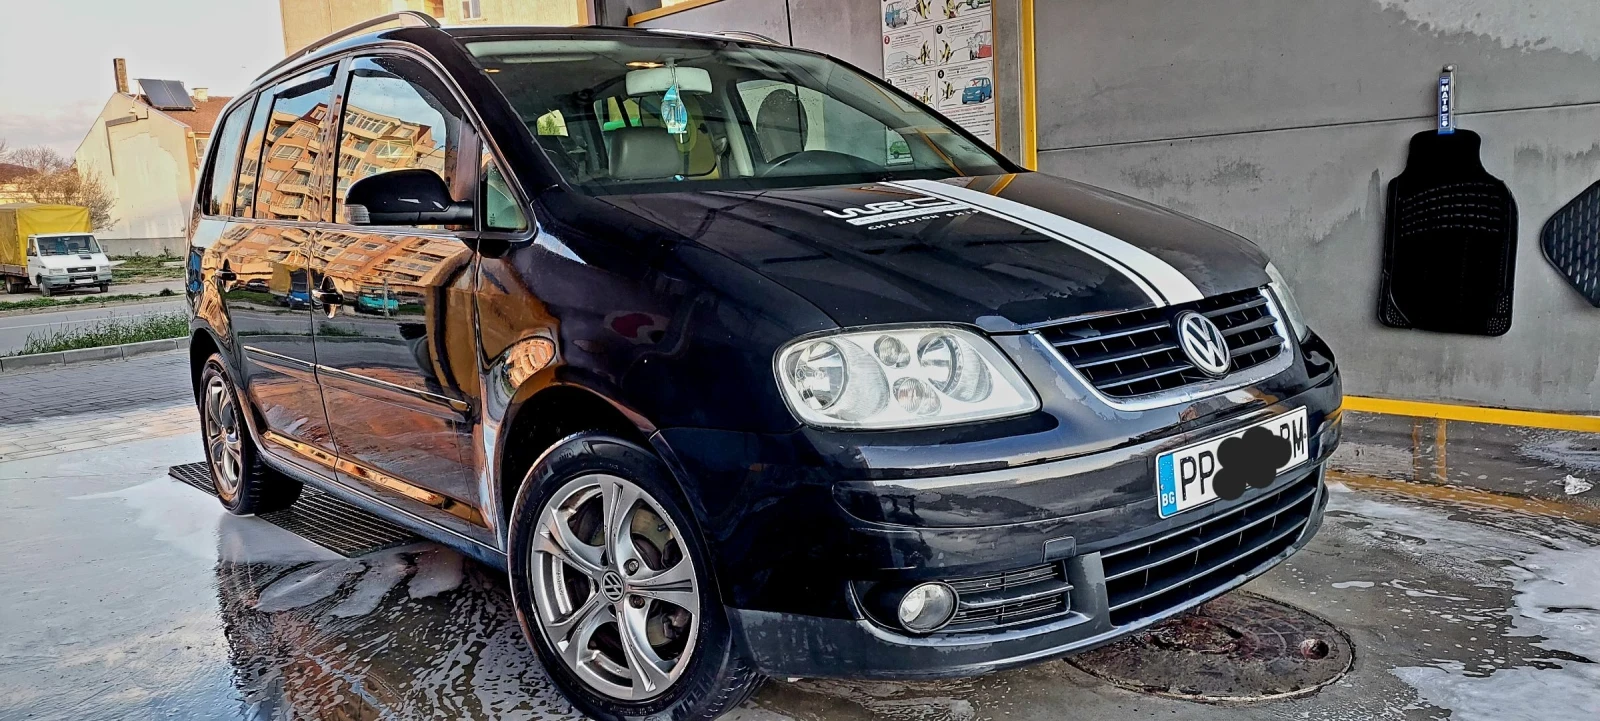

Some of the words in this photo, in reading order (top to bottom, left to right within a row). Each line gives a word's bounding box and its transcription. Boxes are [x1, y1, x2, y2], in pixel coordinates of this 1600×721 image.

[1440, 85, 1449, 112] MATS
[823, 197, 951, 218] WRC
[868, 214, 940, 231] CHAMPION
[1179, 313, 1231, 374] VW
[1180, 450, 1214, 501] PP
[1162, 491, 1176, 507] BG
